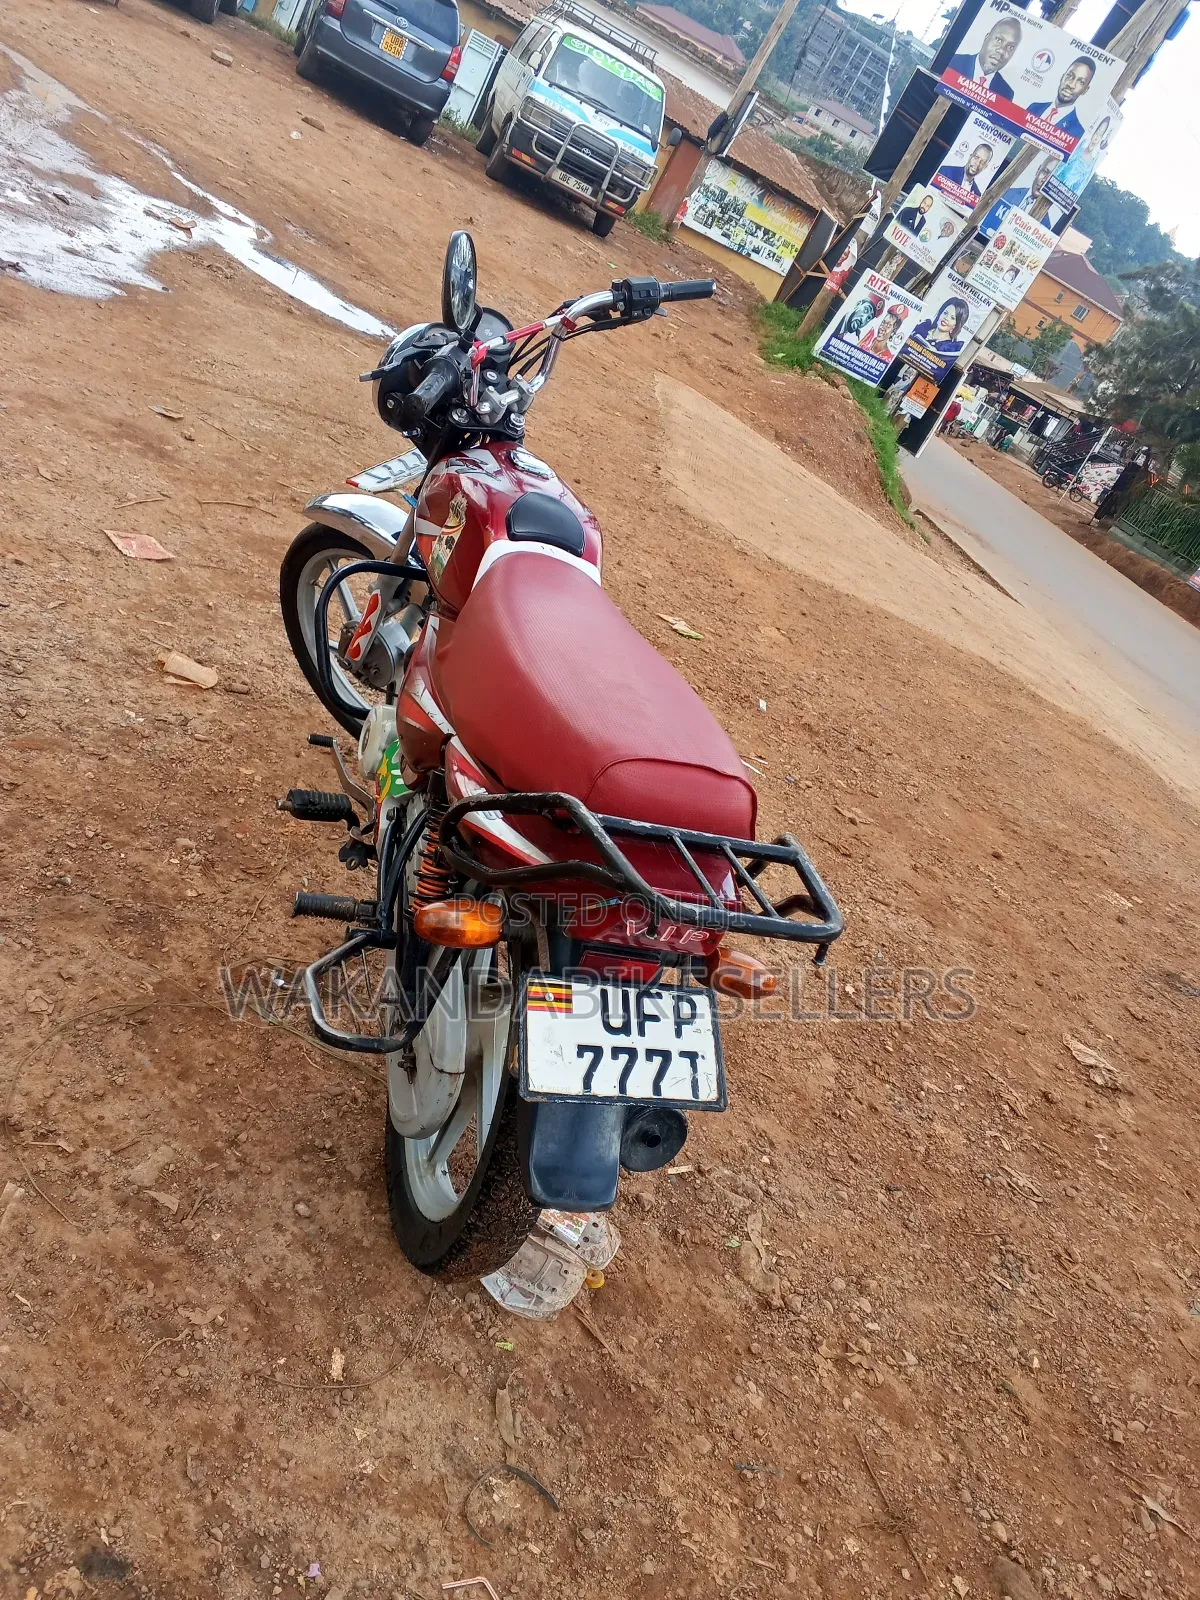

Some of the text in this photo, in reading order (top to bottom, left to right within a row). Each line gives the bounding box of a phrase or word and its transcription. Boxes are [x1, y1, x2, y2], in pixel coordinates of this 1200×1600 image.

[990, 0, 1011, 13] MP
[1069, 38, 1117, 66] PRESIDENT
[582, 43, 648, 86] TOYOTA
[957, 75, 997, 103] KAWALYA
[973, 118, 1012, 146] SSENYONGA
[1025, 113, 1075, 145] KYAGULANYI
[1048, 135, 1068, 149] ROBERT
[558, 172, 590, 195] UBE 754H
[937, 175, 968, 197] COUNCILLOR
[891, 225, 911, 248] VOTE
[1012, 227, 1045, 251] RESTAURANT
[1031, 227, 1055, 249] Palais
[866, 273, 892, 294] RITA
[947, 272, 971, 291] BUTAYI
[969, 287, 992, 308] HELLEN
[889, 289, 923, 312] NAKUBULWA
[828, 336, 851, 353] WOMAN
[600, 988, 698, 1040] UFP
[576, 1044, 700, 1100] 777T
